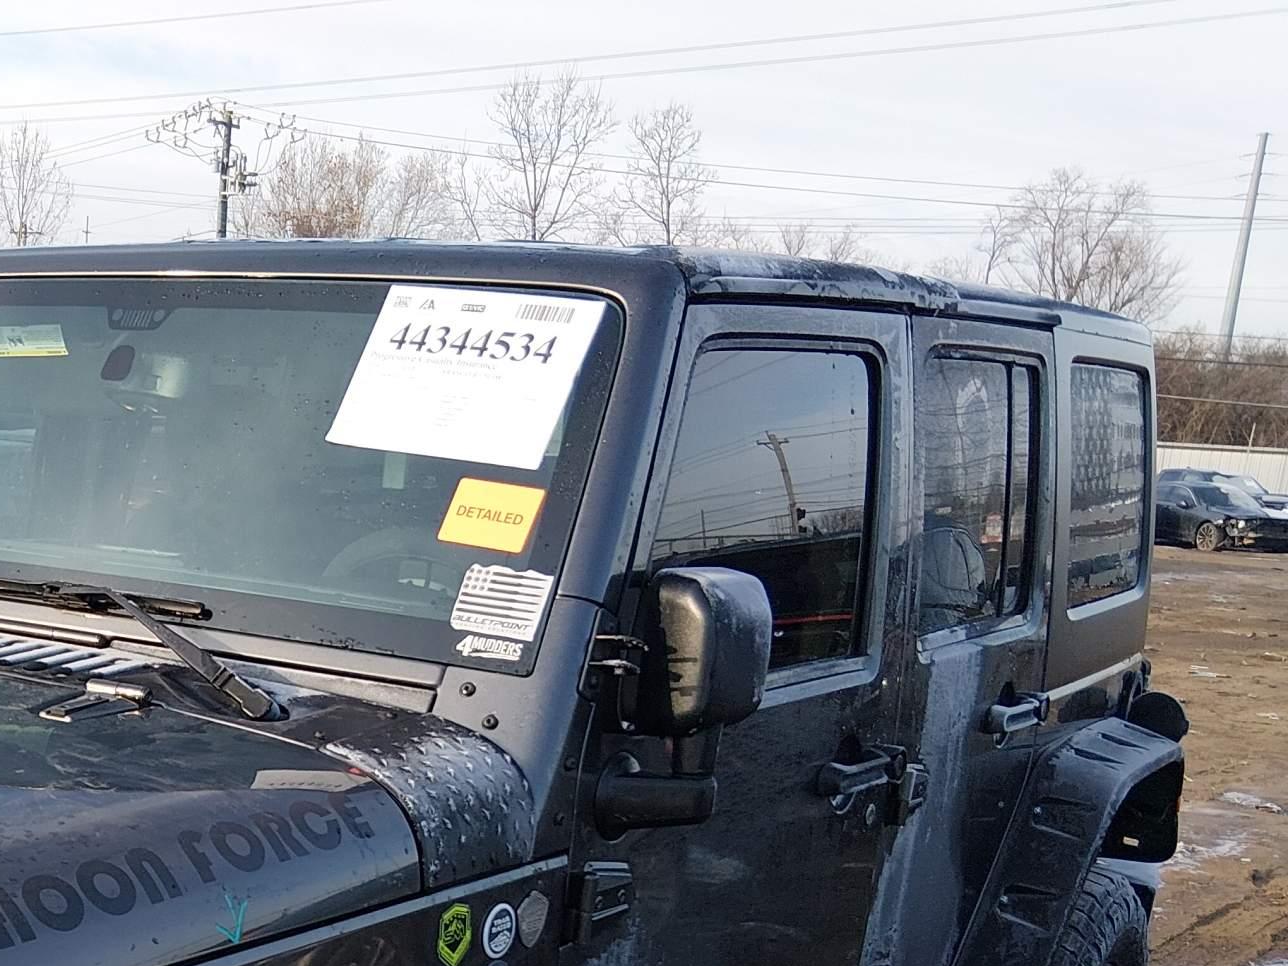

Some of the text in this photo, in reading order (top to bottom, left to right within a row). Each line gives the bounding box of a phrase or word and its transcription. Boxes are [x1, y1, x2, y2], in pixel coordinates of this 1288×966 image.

[389, 322, 558, 365] 44344534
[455, 504, 525, 526] DETAILED
[452, 614, 531, 631] BULLETPOINT
[179, 796, 376, 885] FORCE
